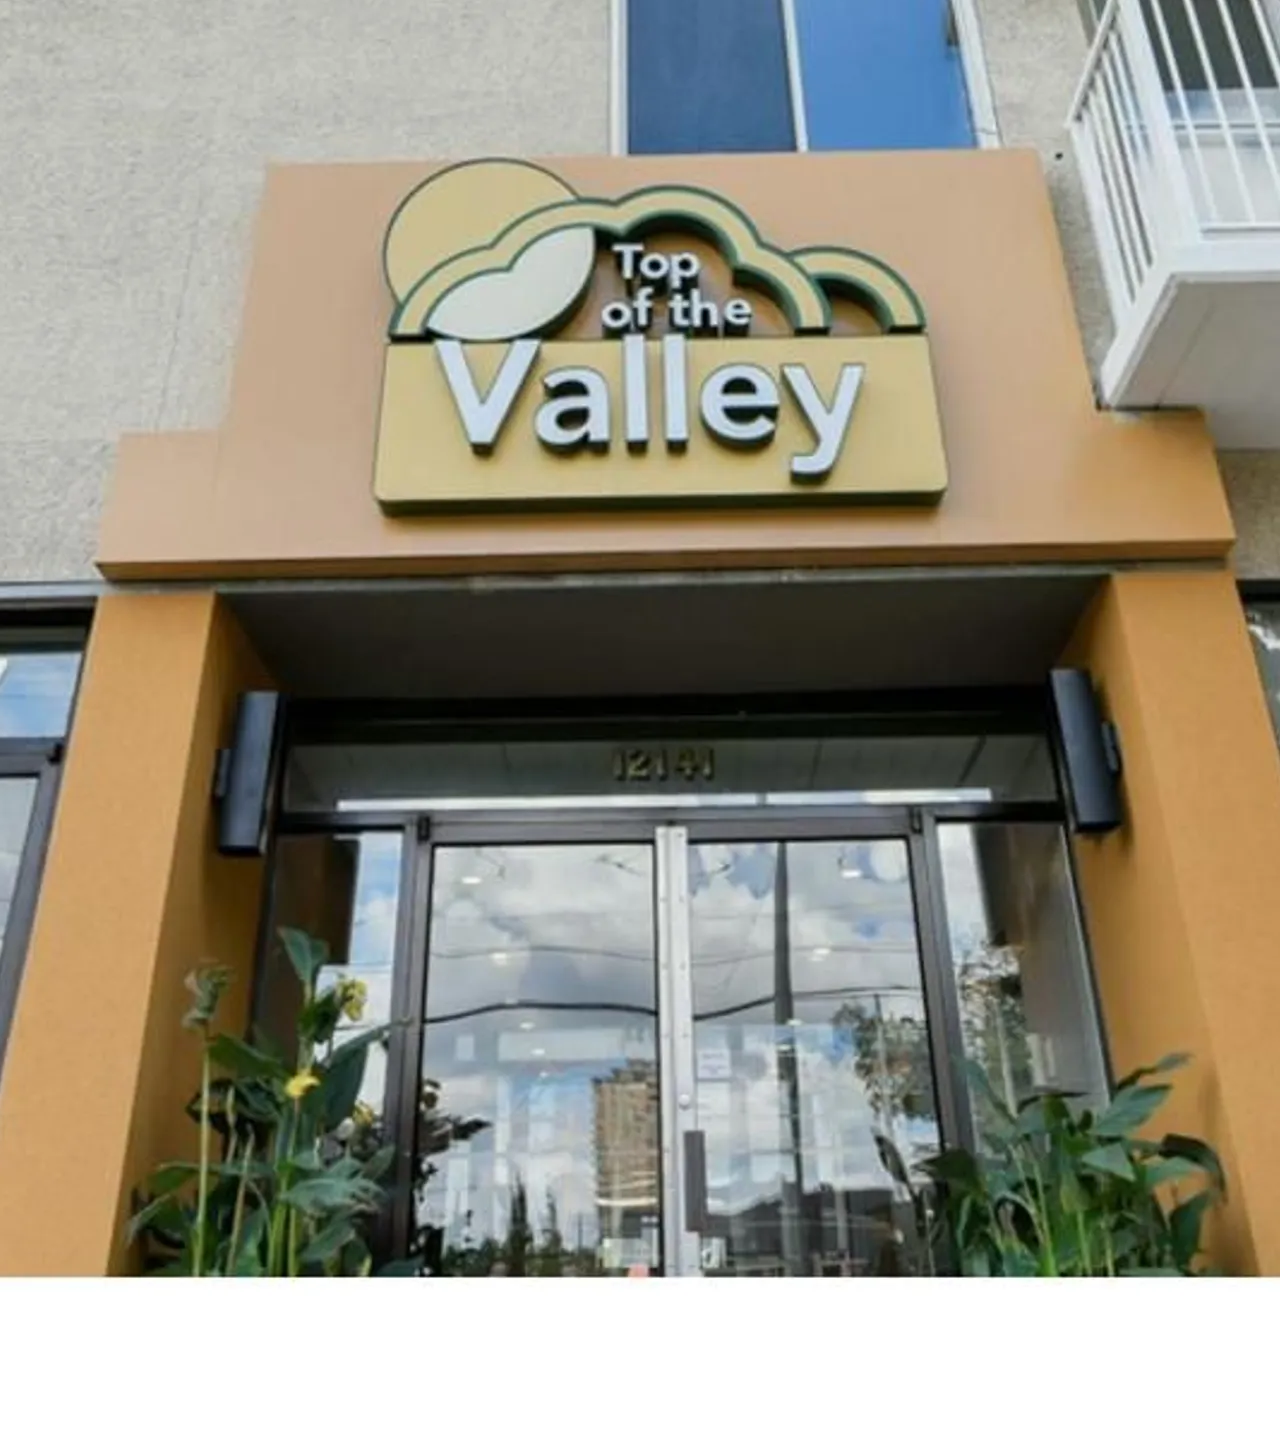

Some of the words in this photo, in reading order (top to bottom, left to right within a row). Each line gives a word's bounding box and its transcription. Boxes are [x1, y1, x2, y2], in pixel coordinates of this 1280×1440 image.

[611, 243, 700, 288] Top
[601, 288, 653, 328] of
[668, 288, 753, 328] the
[434, 333, 866, 478] Valley
[613, 747, 715, 781] 12141
